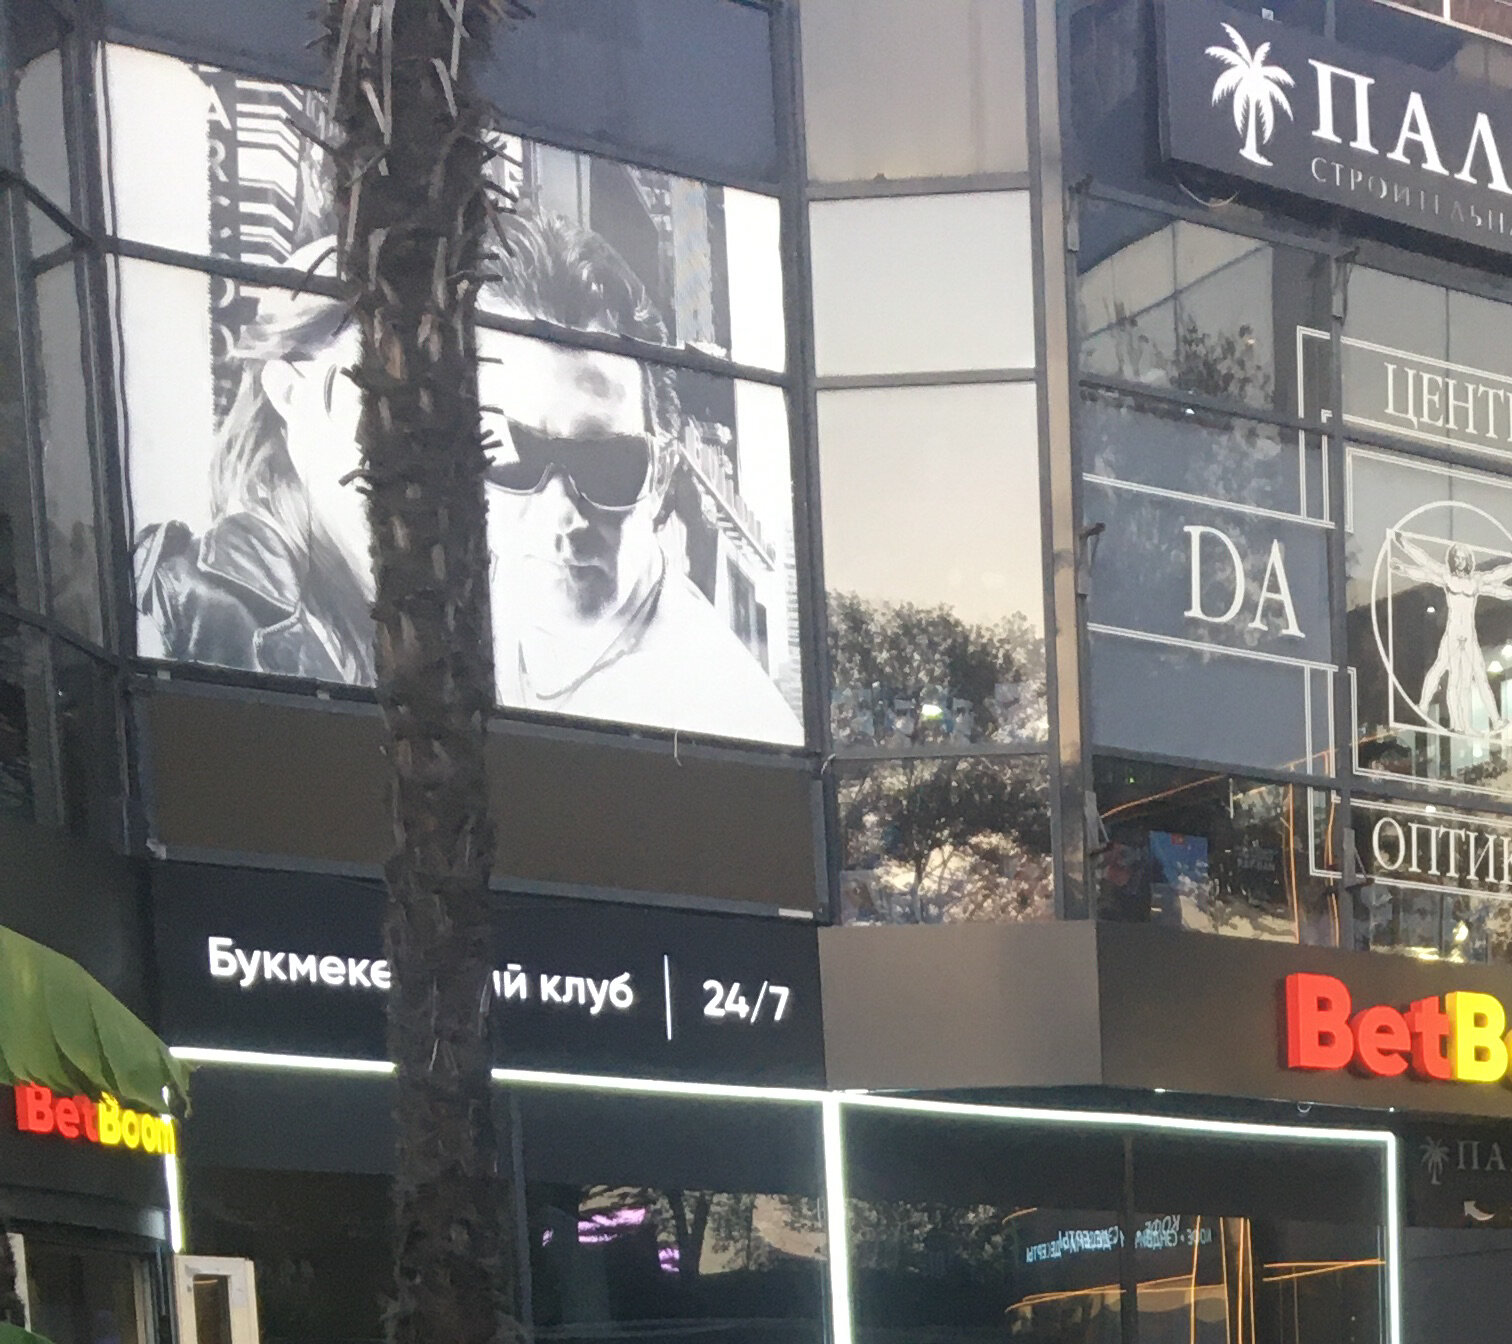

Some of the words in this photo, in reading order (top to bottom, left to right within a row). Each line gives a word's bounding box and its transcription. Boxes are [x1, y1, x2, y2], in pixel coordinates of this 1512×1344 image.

[1184, 525, 1306, 638] DA
[540, 972, 634, 1015] клуб
[702, 979, 790, 1023] 24/7
[14, 1081, 176, 1155] BetBoom
